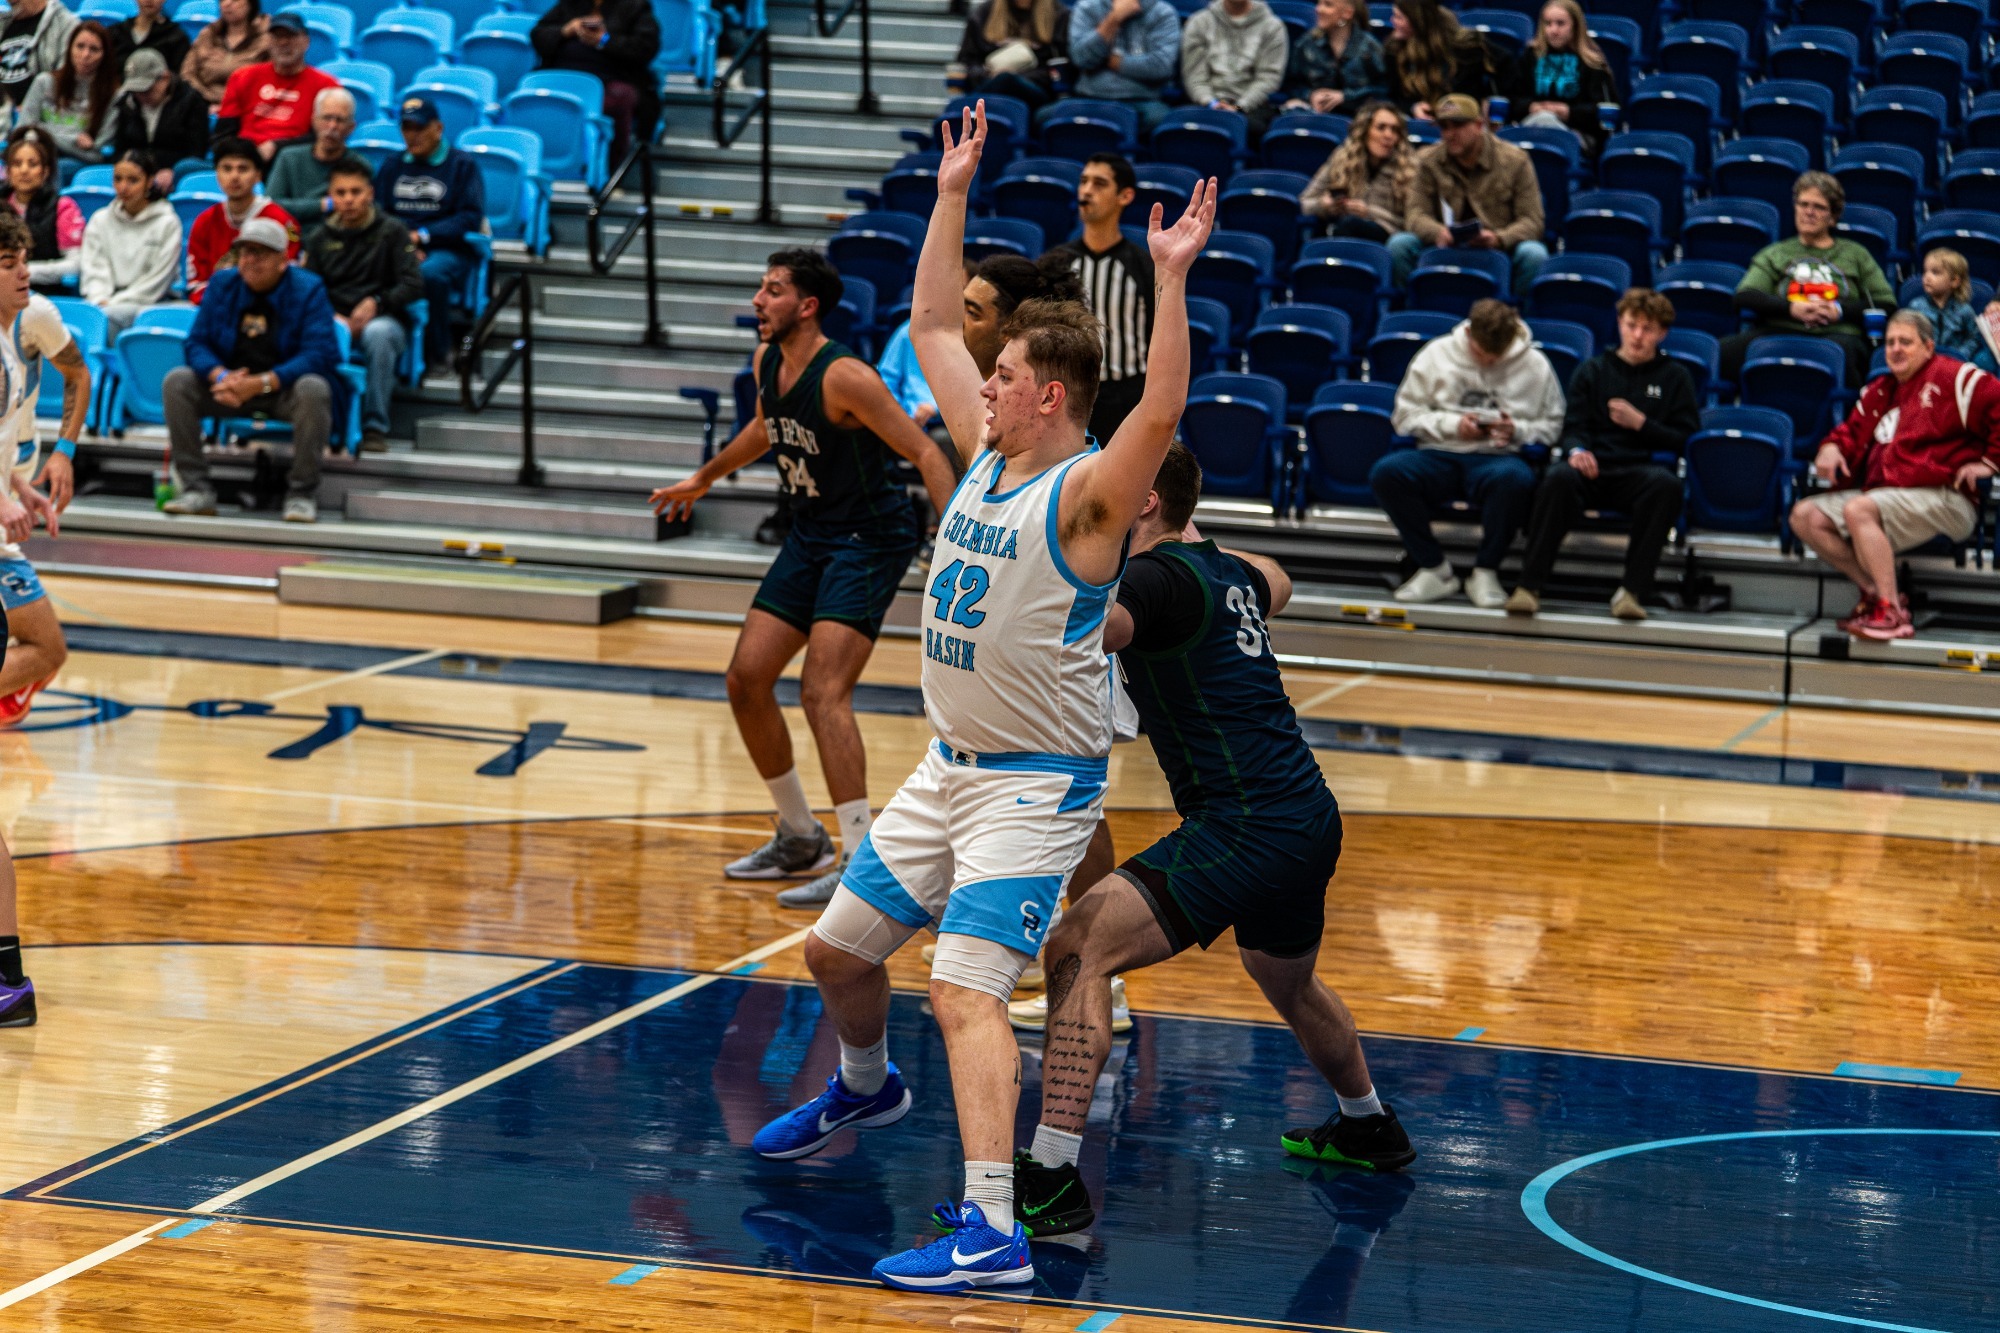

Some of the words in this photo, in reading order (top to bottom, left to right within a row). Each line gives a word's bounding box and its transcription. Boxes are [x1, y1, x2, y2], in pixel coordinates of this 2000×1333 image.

[765, 417, 779, 444] IG
[944, 510, 1019, 560] COLMBIA
[930, 558, 990, 629] 42
[927, 627, 976, 672] BASIN
